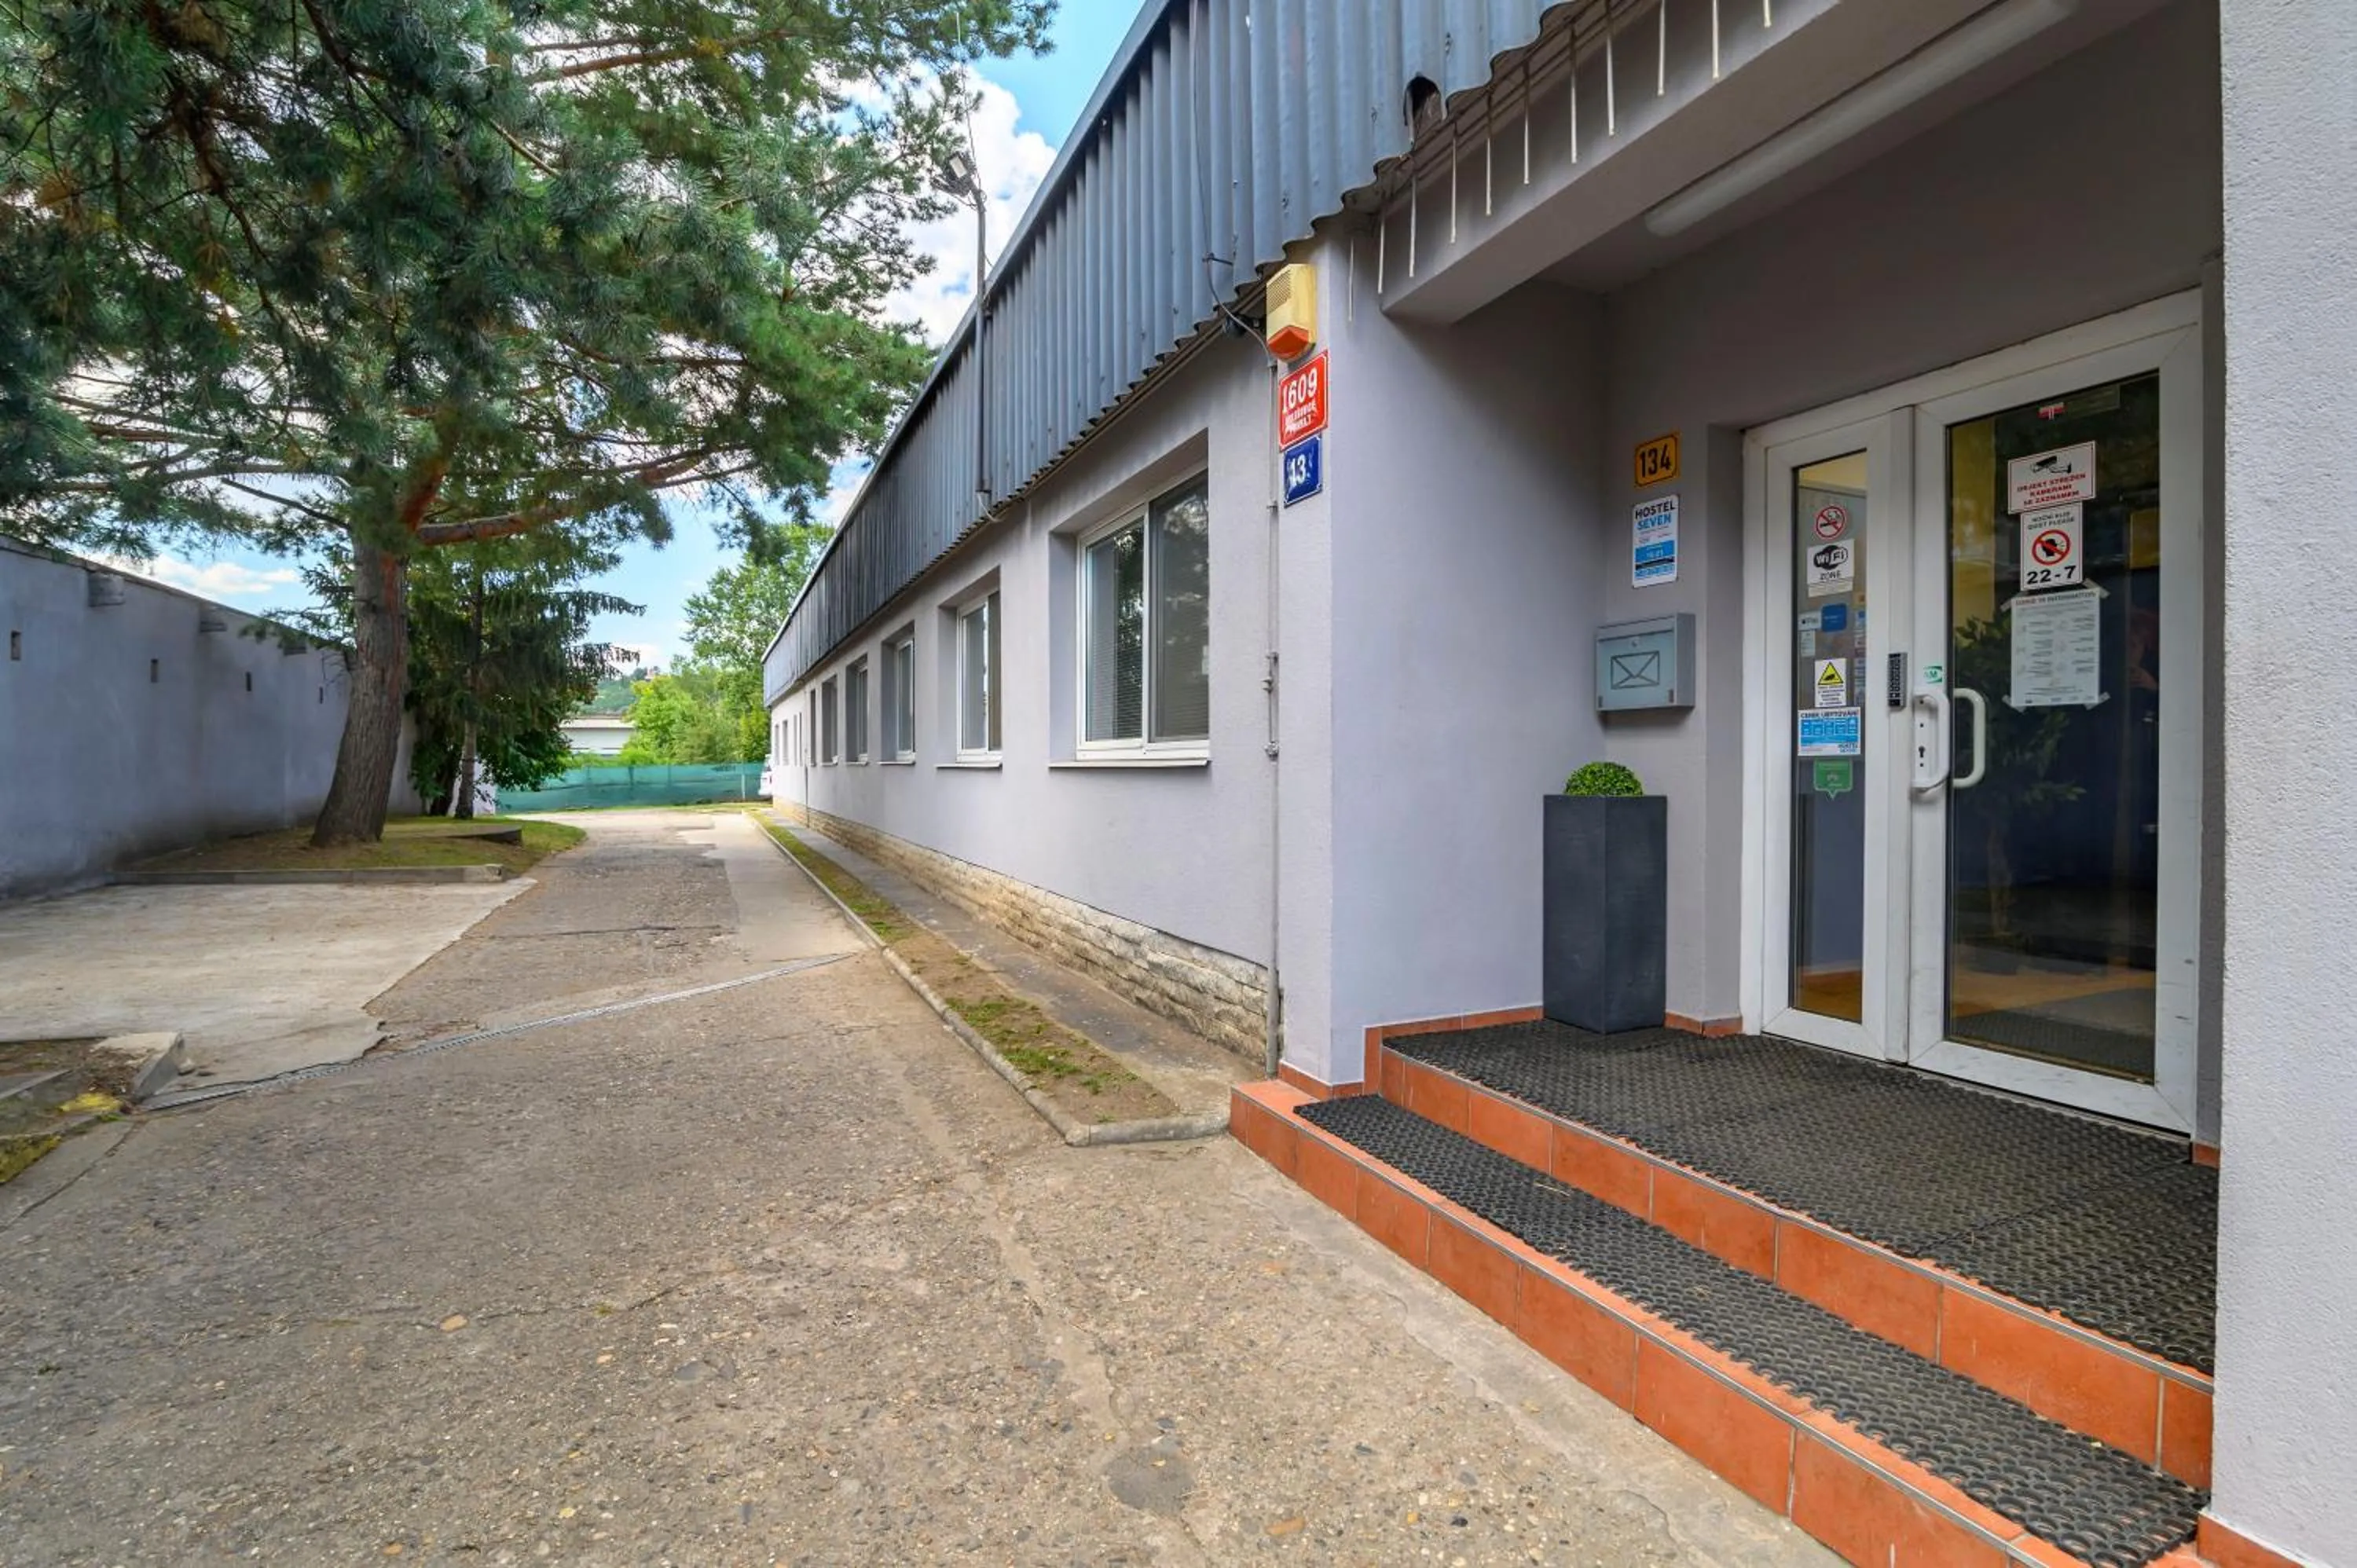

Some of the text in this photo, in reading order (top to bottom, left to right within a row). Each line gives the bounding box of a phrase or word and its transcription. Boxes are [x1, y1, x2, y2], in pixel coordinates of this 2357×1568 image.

[1283, 367, 1318, 412] 1609
[1639, 443, 1672, 478] 134
[1635, 500, 1675, 519] HOSTEL
[1637, 513, 1672, 530] SEVEN
